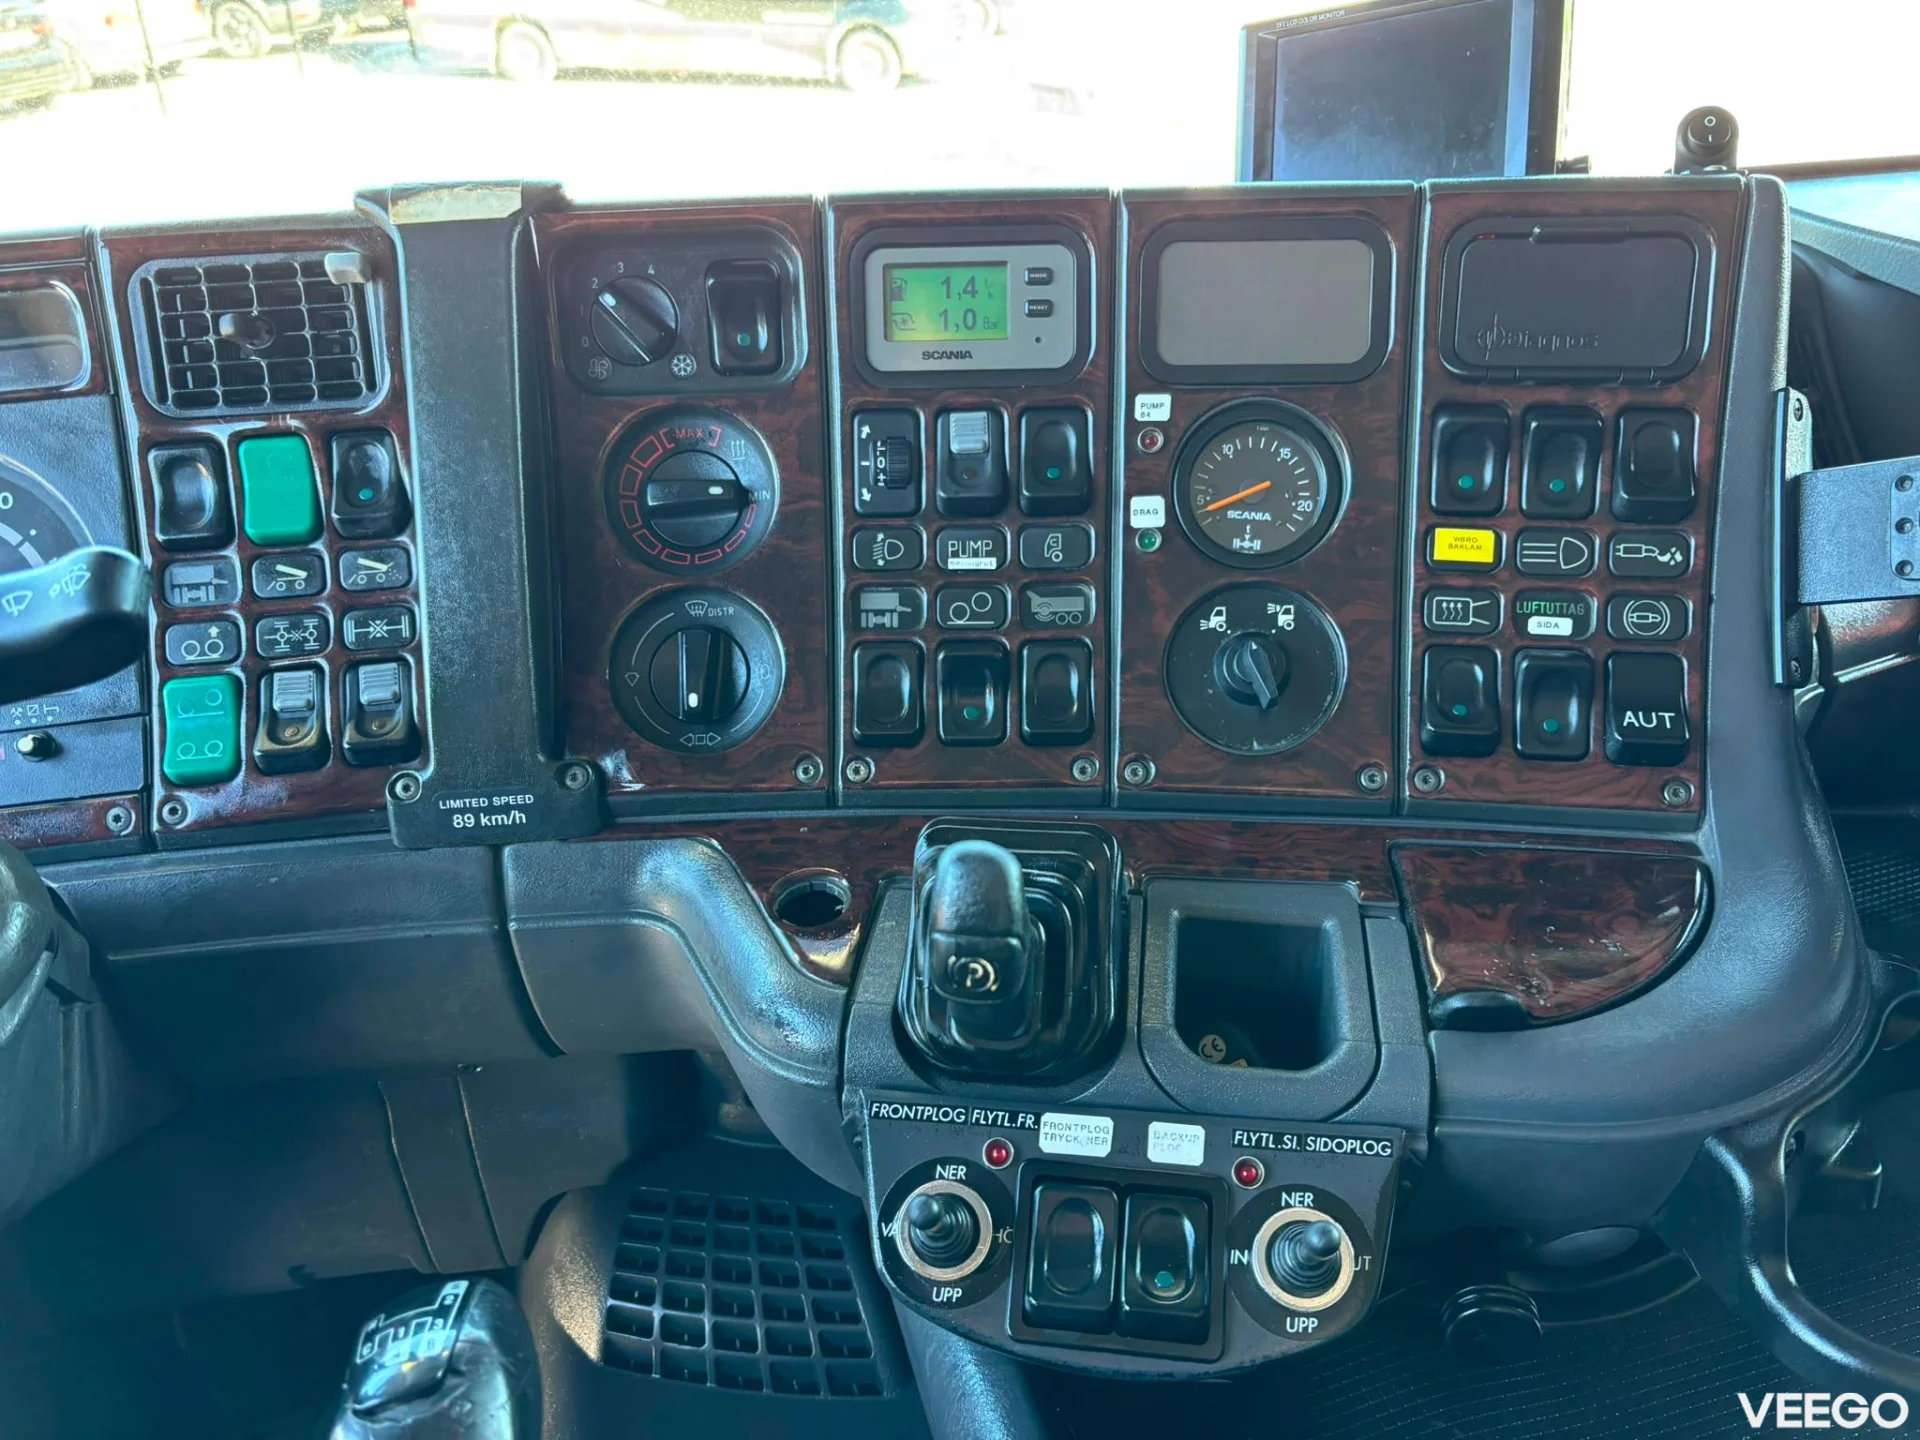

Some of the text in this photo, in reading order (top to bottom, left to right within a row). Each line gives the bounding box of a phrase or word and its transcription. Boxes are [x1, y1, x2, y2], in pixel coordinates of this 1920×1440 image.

[617, 261, 625, 274] 3
[647, 264, 656, 275] 4
[591, 277, 599, 289] 2
[941, 275, 978, 300] 1,4
[939, 307, 999, 332] 1,0 Bar
[921, 350, 974, 360] SCANIA
[1140, 402, 1165, 410] PUMP
[675, 427, 704, 439] MAX
[1221, 443, 1234, 455] 10
[1279, 448, 1291, 460] 15
[748, 490, 771, 502] MIN
[1133, 508, 1159, 517] DRAG
[1296, 500, 1313, 512] 20
[1226, 510, 1272, 521] SCANIA
[948, 540, 993, 558] PUMP
[708, 606, 735, 617] DISTR
[1515, 601, 1585, 616] LUFTUTTAG
[1536, 621, 1560, 629] SIDA
[1623, 710, 1676, 730] AUT
[439, 794, 534, 810] LIMITED SPEED
[453, 810, 527, 828] 89 km/h
[871, 1103, 966, 1123] FRONTPLOG
[972, 1109, 1038, 1129] FLYTL.FR.
[1042, 1121, 1110, 1135] FRONTPLOG
[1305, 1136, 1392, 1156] SIDOPLOG
[935, 1164, 967, 1180] NER
[1281, 1191, 1314, 1207] NER
[1230, 1249, 1249, 1265] IN
[443, 1294, 455, 1306] 2
[932, 1287, 963, 1303] UPP
[1285, 1317, 1318, 1333] UPP
